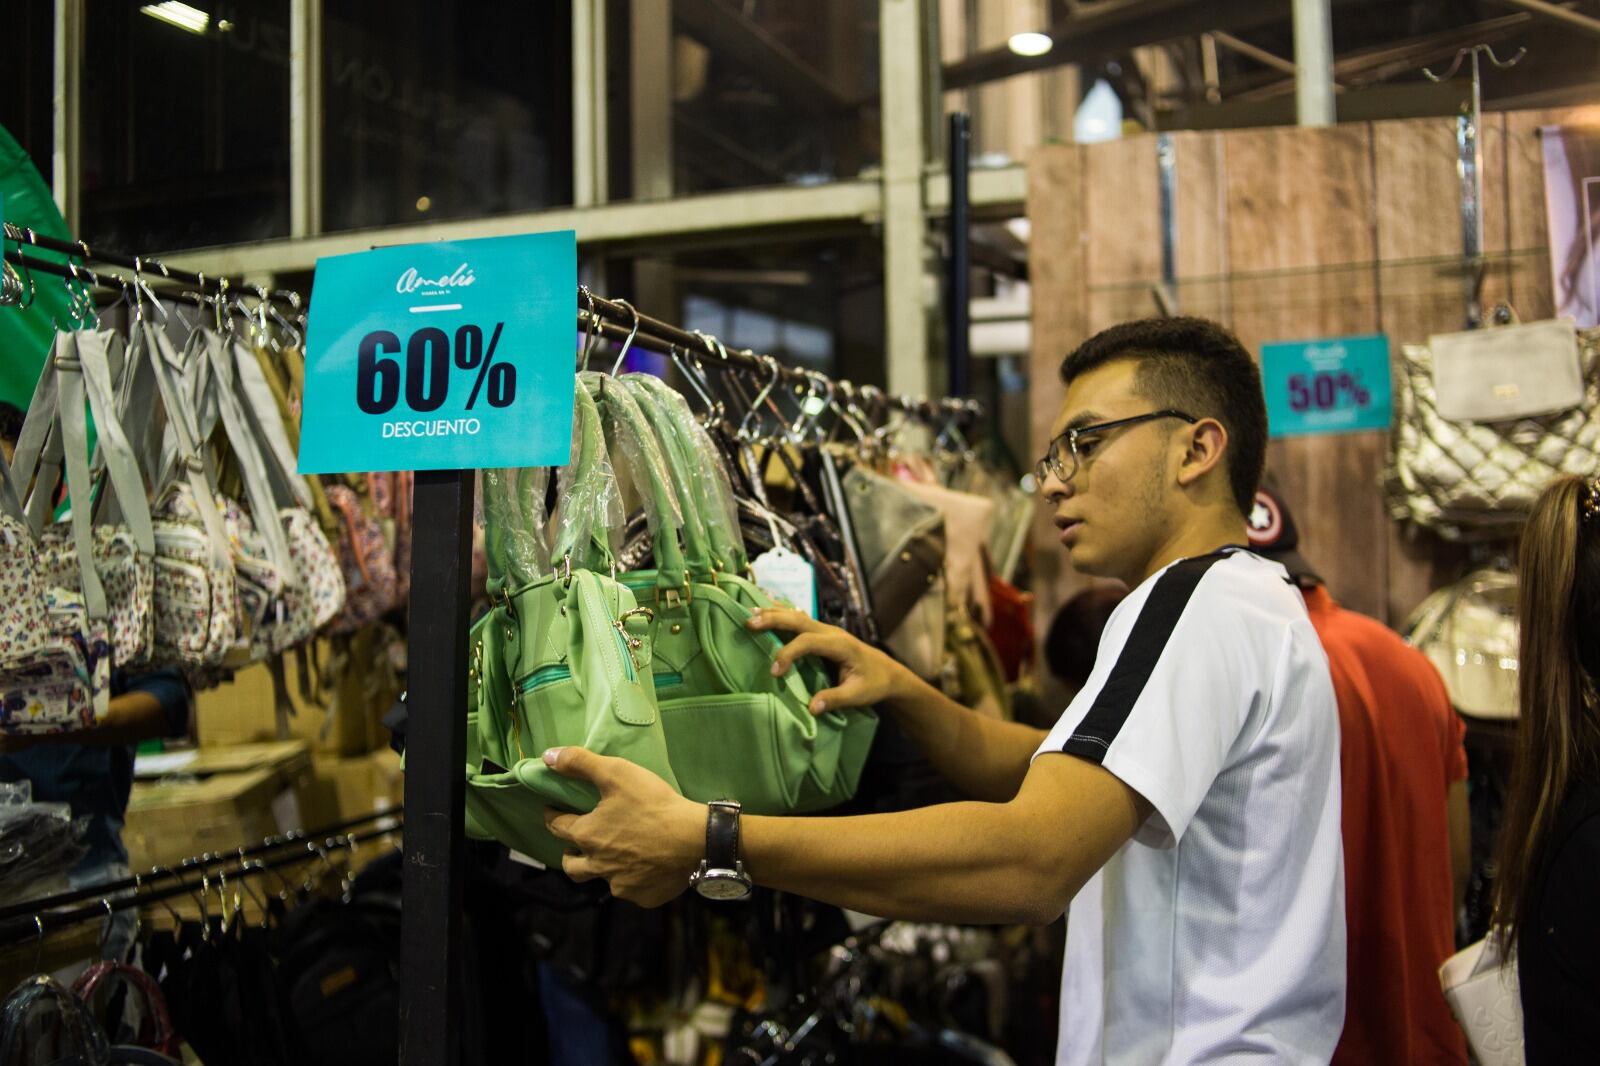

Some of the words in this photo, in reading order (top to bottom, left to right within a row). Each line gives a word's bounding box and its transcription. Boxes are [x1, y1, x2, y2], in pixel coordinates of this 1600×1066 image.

[356, 322, 517, 415] 60%
[1287, 368, 1370, 412] 50%
[382, 418, 481, 438] DESCUENTO
